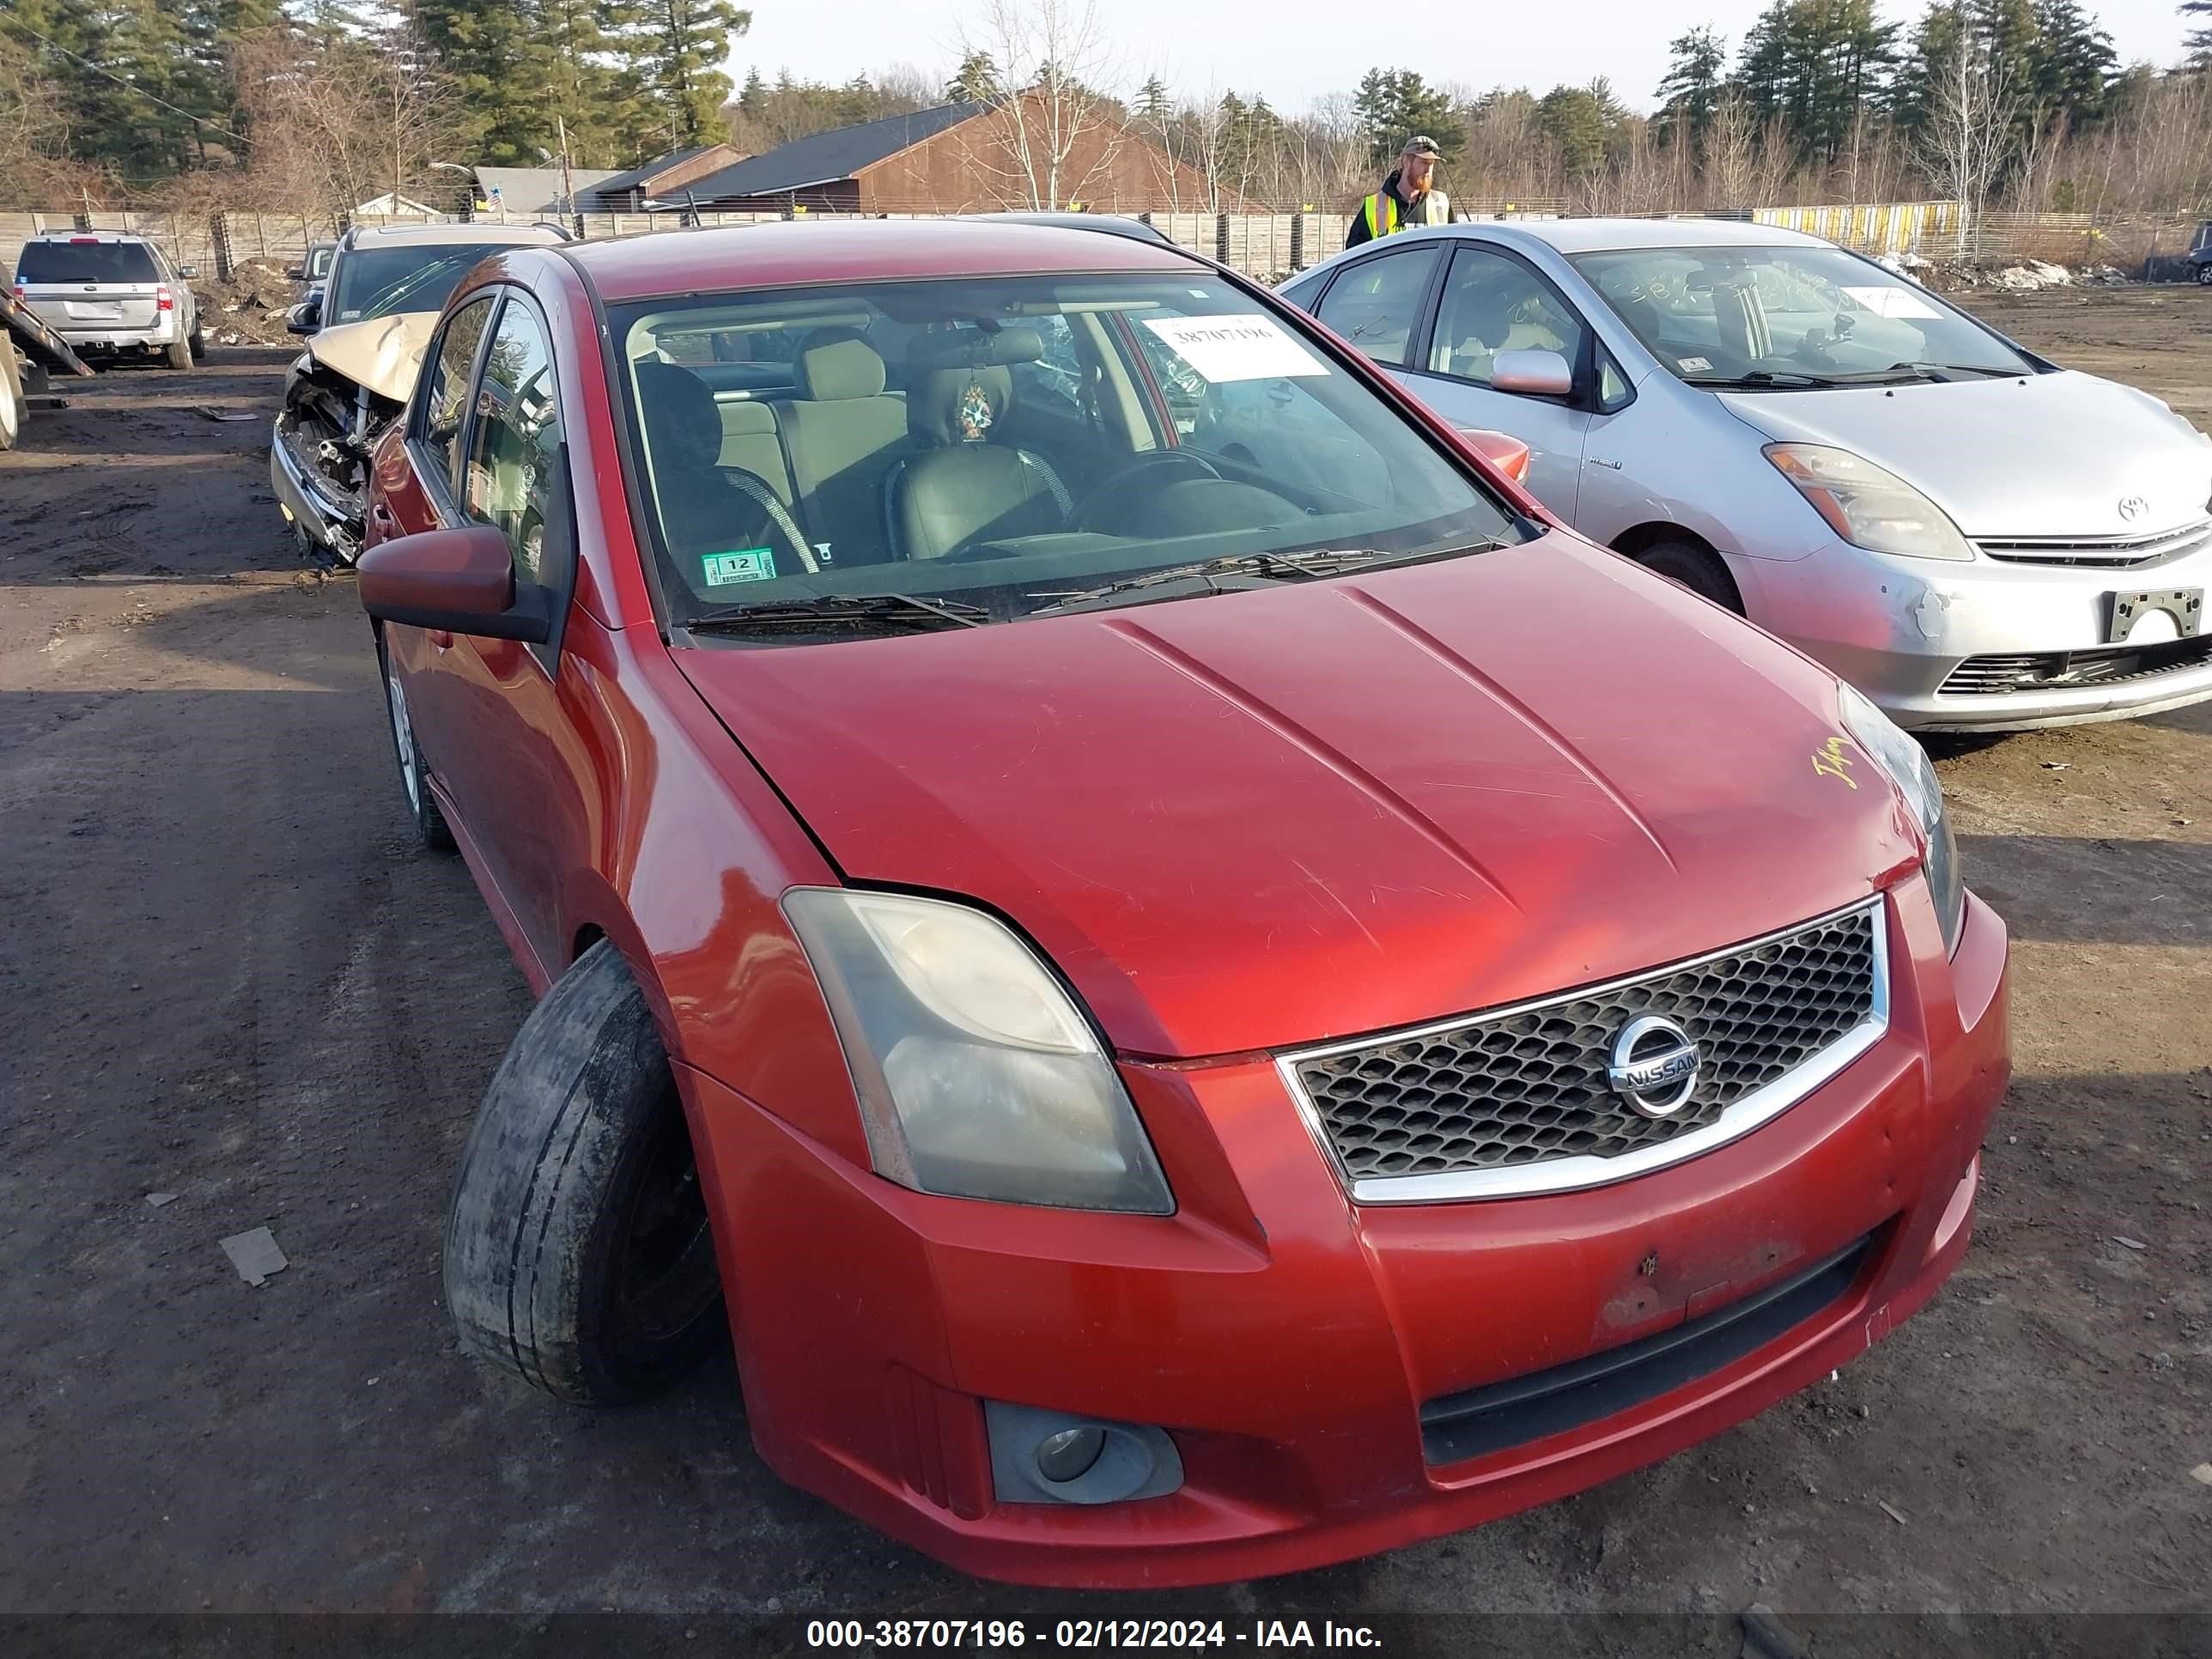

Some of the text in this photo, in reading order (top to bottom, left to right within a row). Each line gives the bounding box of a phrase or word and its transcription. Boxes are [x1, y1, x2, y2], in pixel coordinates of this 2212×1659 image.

[1173, 328, 1273, 344] 38707196
[727, 558, 750, 570] 12
[1626, 1049, 1699, 1088] NISSAN
